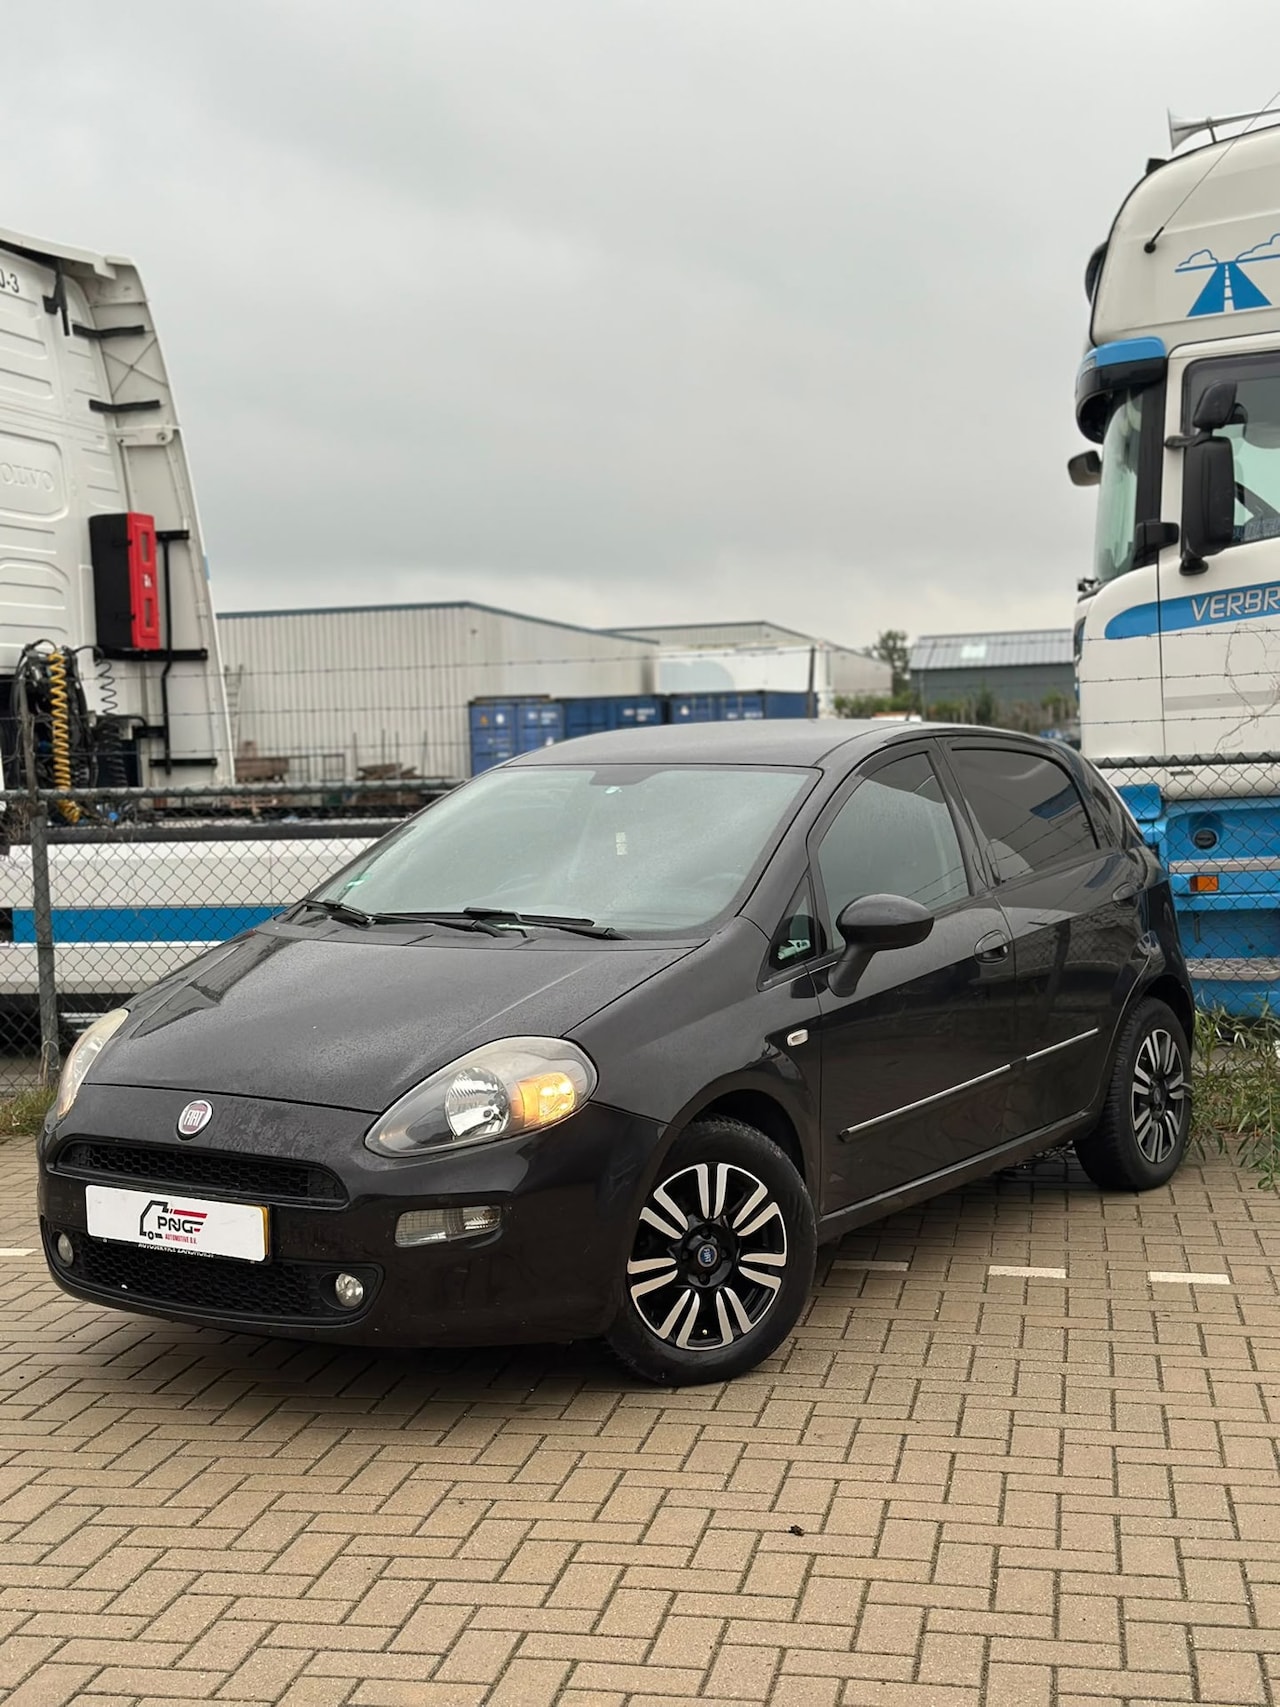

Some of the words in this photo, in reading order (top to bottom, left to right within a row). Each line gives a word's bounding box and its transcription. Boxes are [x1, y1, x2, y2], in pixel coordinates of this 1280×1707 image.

[1191, 586, 1280, 622] VERBR
[184, 1110, 206, 1126] FIAT
[157, 1215, 204, 1235] PNG
